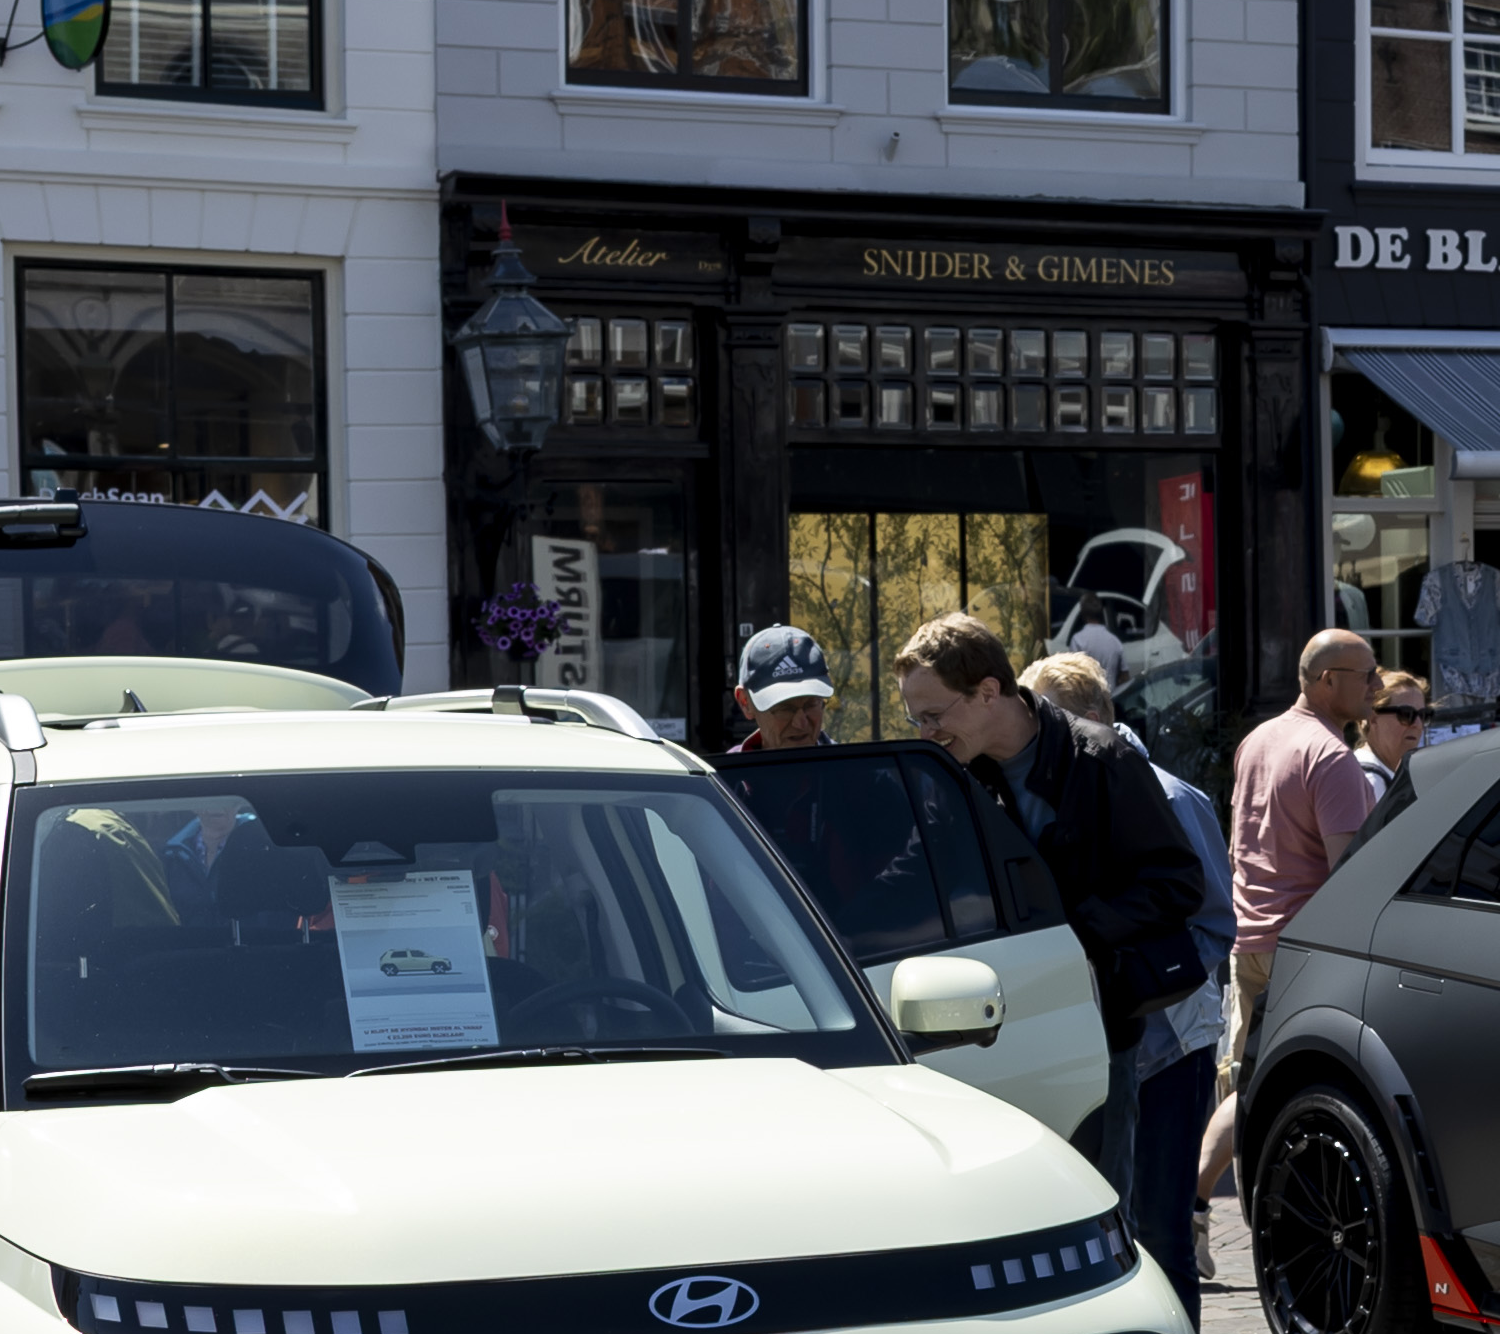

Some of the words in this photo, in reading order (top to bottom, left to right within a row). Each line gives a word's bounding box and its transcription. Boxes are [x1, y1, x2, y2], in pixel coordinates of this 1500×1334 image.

[557, 236, 670, 267] Atelier
[1333, 225, 1410, 270] DE
[863, 248, 993, 281] SNIJDER
[1004, 255, 1027, 281] &
[1037, 255, 1176, 286] GIMENES
[771, 666, 804, 678] adidas
